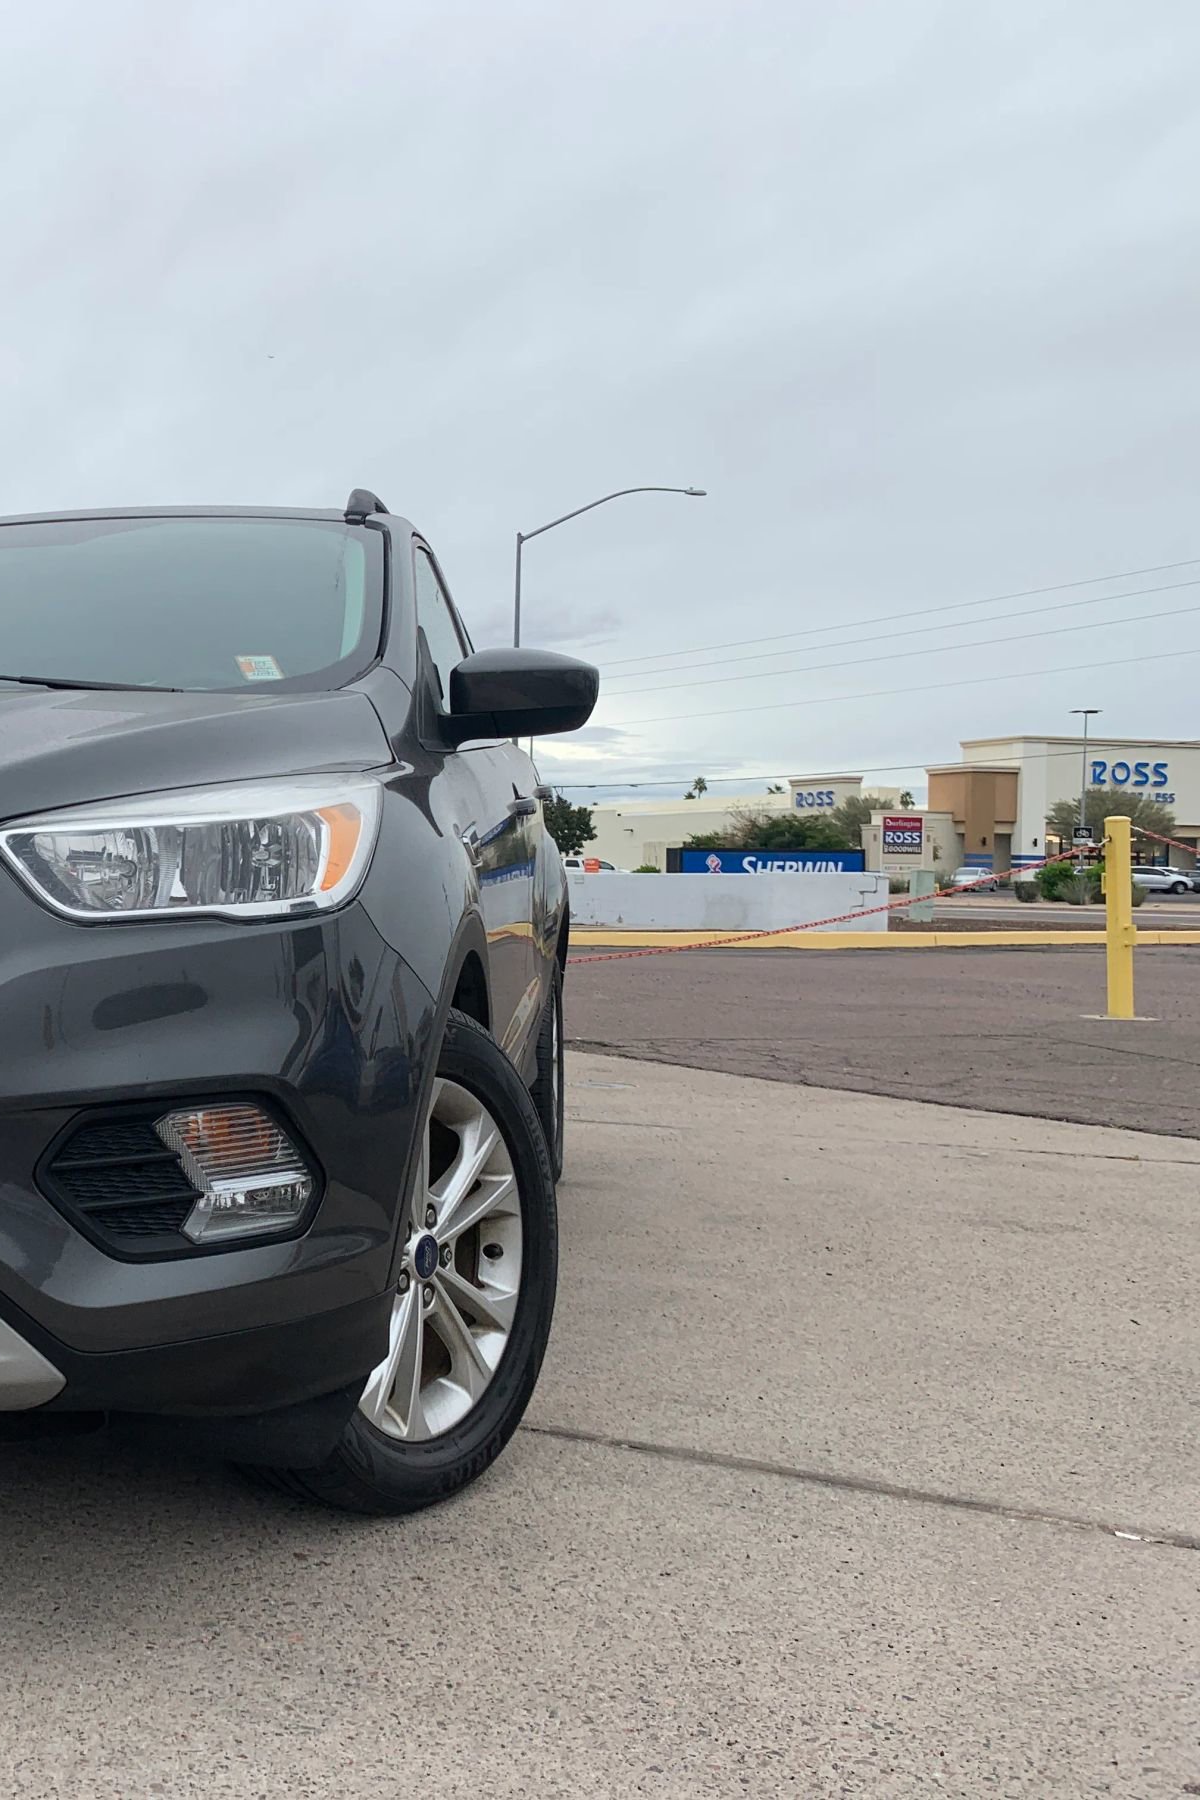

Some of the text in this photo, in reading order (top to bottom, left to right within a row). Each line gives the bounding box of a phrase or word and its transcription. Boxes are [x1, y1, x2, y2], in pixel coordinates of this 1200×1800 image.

[1090, 760, 1169, 787] ROSS
[795, 790, 835, 808] ROSS
[885, 831, 921, 844] ROSS
[742, 856, 834, 873] SHERWIN
